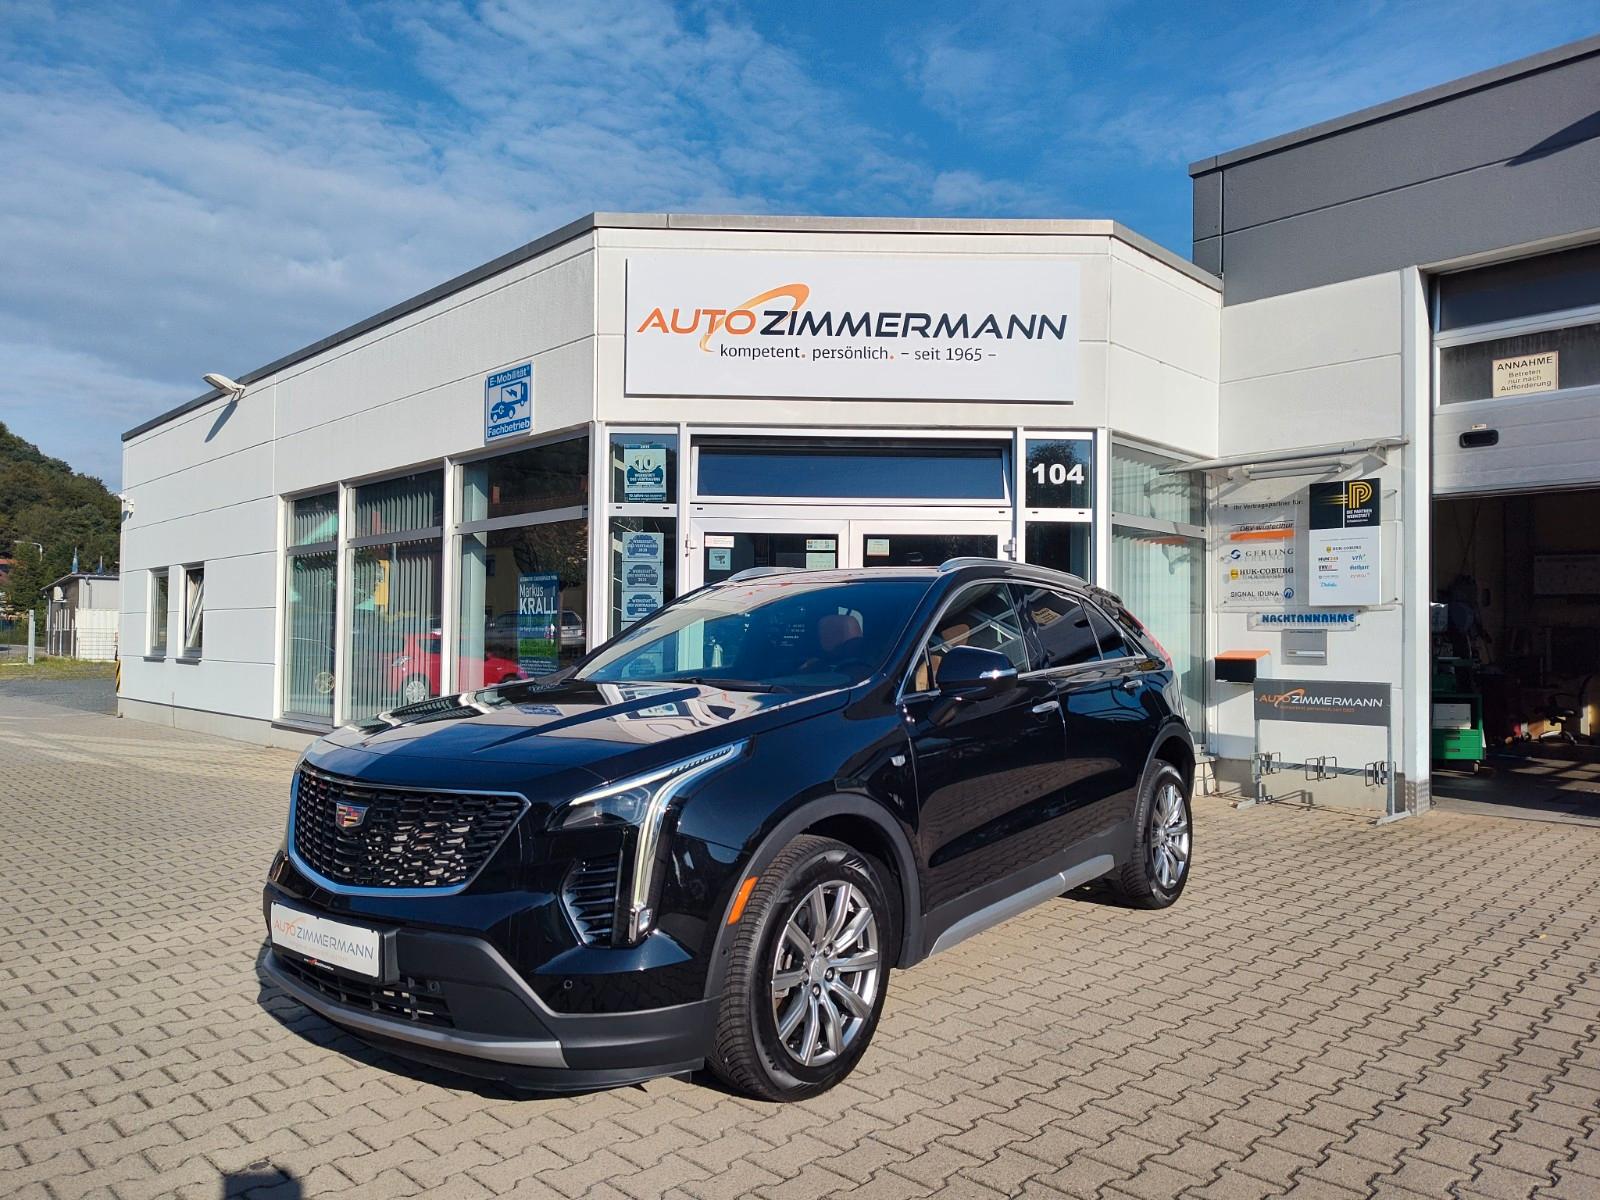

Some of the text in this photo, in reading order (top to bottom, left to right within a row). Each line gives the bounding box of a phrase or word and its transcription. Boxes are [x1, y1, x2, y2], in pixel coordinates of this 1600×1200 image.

[759, 309, 1068, 340] ZIMMERMANN
[719, 343, 806, 361] kompetent.
[812, 345, 895, 362] persönlich.
[914, 347, 941, 361] seit
[945, 347, 983, 362] 1965
[1496, 355, 1553, 371] ANNAHME
[1508, 369, 1541, 378] Betreten
[1500, 380, 1552, 391] Aufforderung
[488, 419, 530, 437] Fachbetrieb
[1032, 463, 1085, 485] 104
[1244, 501, 1291, 510] Vertragspartner
[1245, 548, 1294, 557] GERLING
[1240, 566, 1294, 576] HUK-COBURG
[519, 583, 544, 598] Markus
[519, 597, 558, 615] KRALL
[1261, 613, 1355, 623] NACHTANNAHME
[1291, 695, 1383, 708] ZIMMERMANN
[296, 926, 374, 960] ZIMMERMANN
